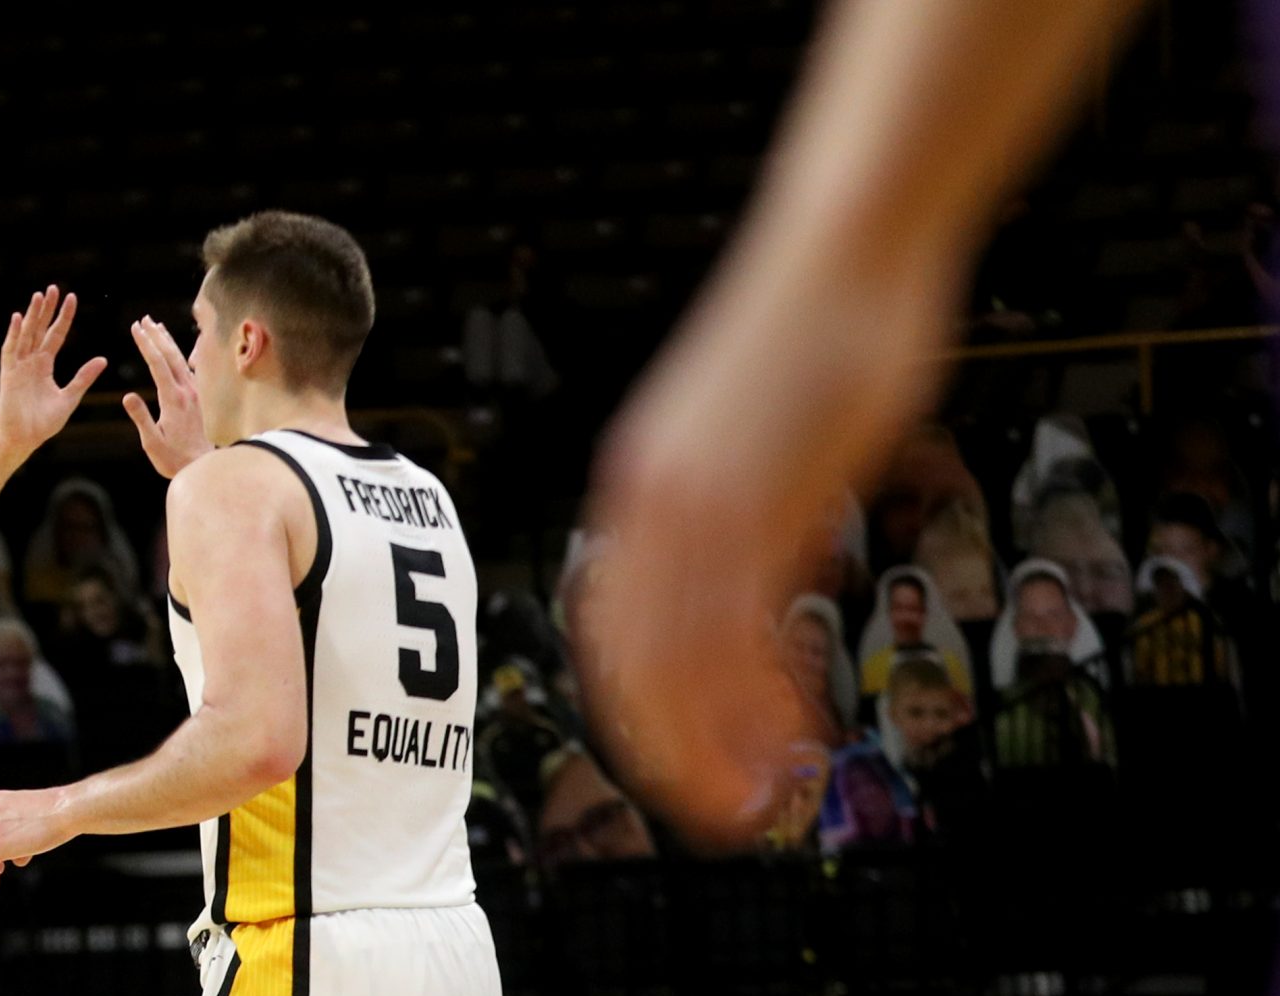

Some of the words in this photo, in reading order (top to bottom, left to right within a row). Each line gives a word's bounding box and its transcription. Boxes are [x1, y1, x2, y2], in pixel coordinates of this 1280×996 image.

[336, 474, 453, 529] FREDRICK
[390, 542, 460, 701] 5
[348, 710, 471, 773] EQUALITY
